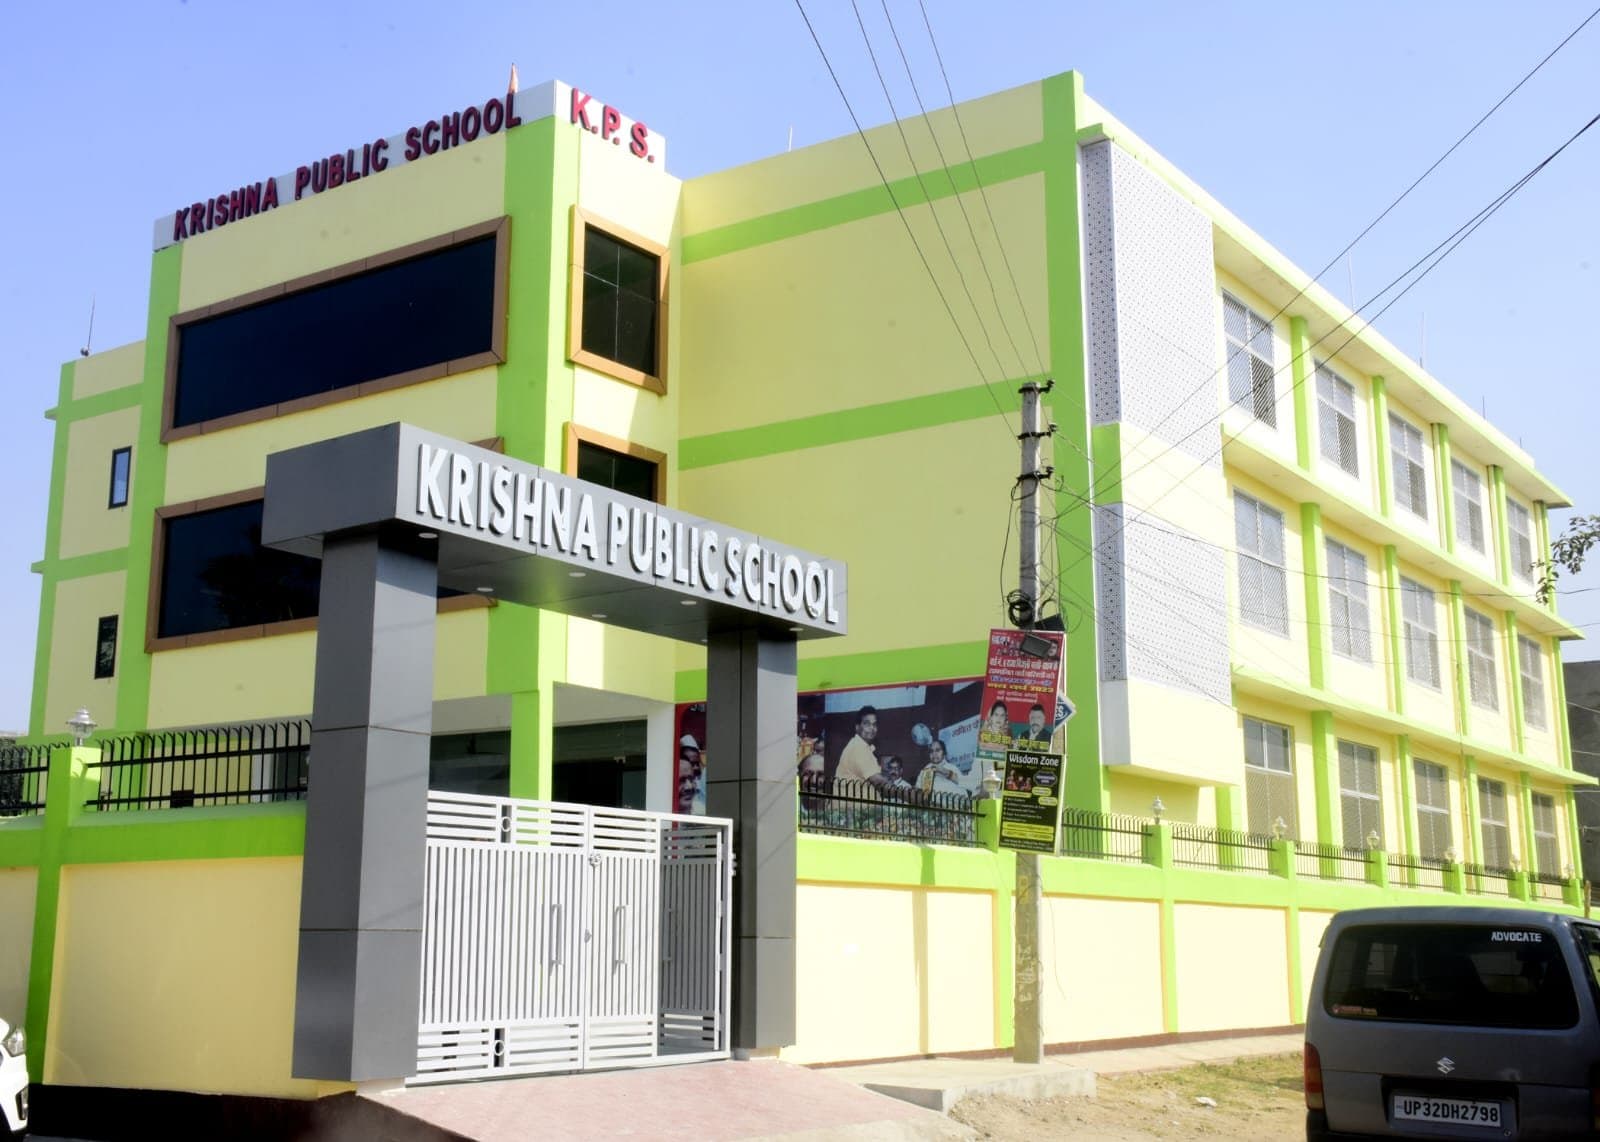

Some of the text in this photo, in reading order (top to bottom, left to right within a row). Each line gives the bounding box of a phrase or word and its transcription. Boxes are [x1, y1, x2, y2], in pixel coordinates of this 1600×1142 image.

[173, 92, 522, 241] KRISHNA PUBLIC SCHOOL
[416, 443, 840, 624] KRISHNA PUBLIC SCHOOL
[1009, 753, 1039, 764] Wisdom
[1040, 757, 1060, 767] Zone
[1491, 931, 1543, 942] ADVOCATE
[1403, 1100, 1499, 1123] UP32DH2798
